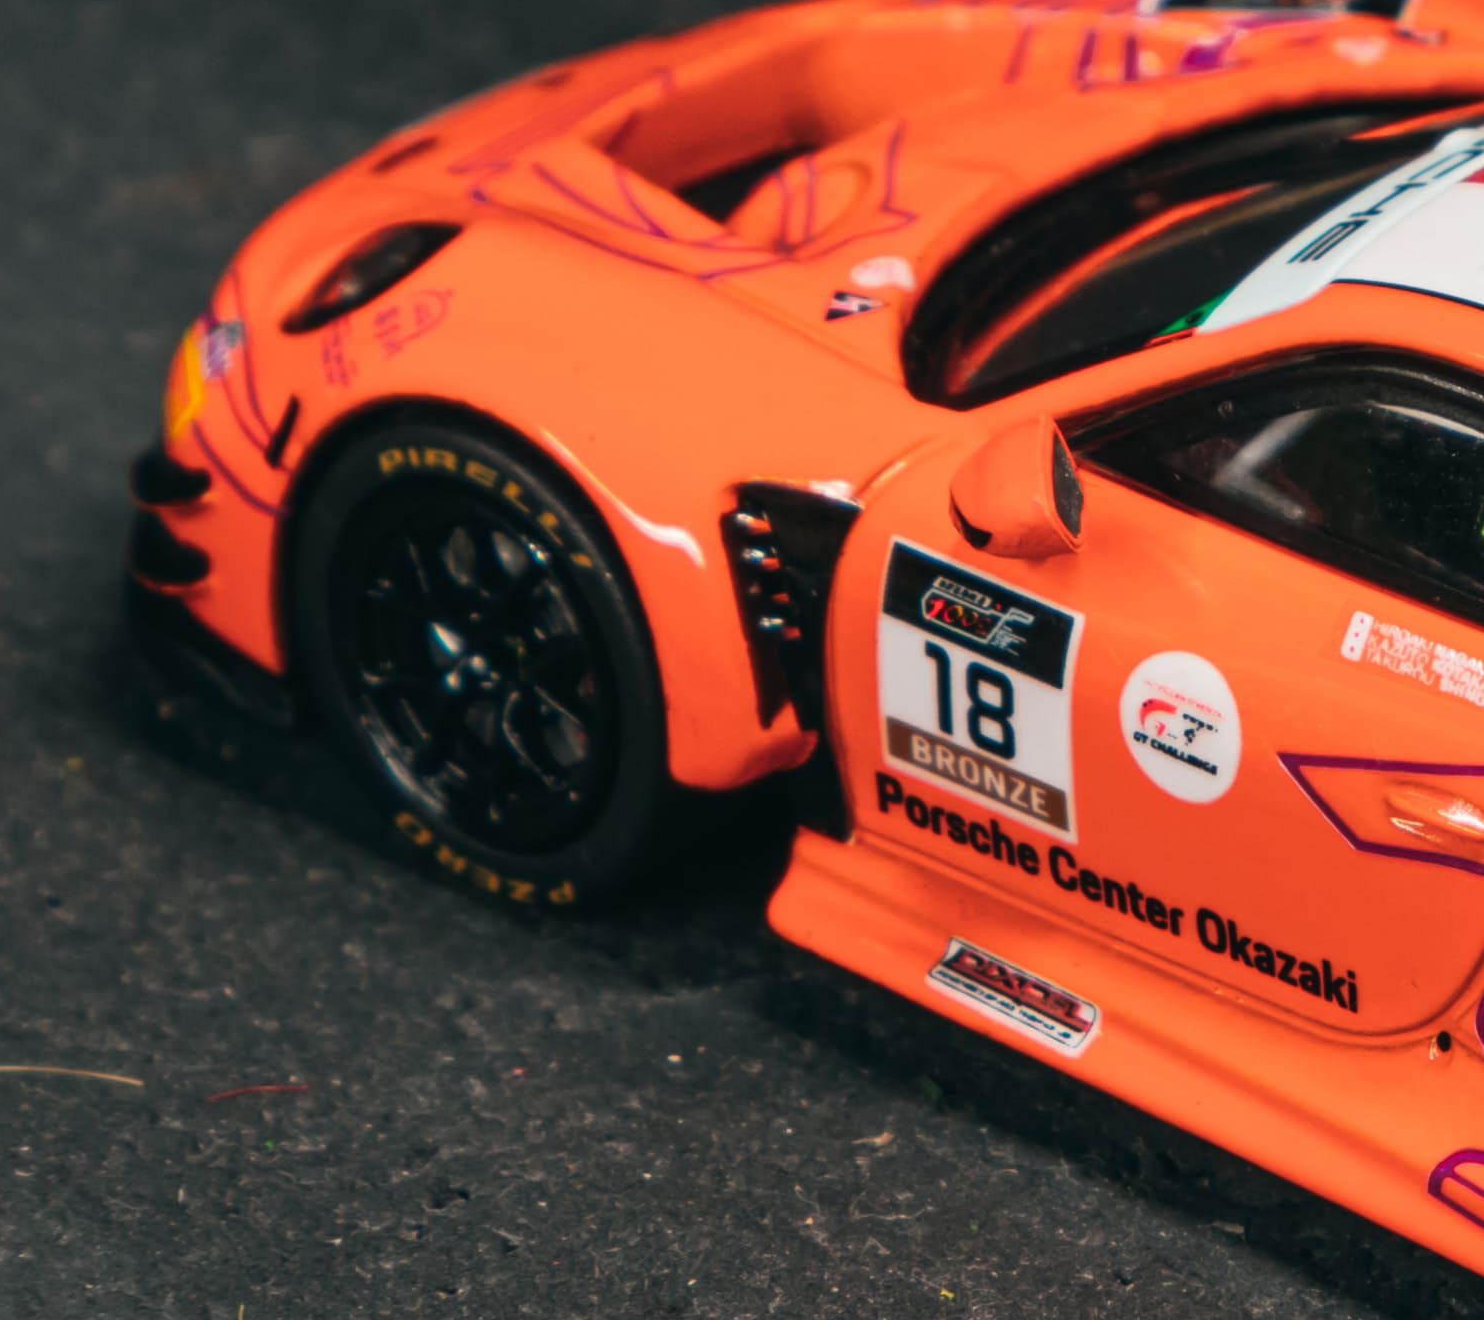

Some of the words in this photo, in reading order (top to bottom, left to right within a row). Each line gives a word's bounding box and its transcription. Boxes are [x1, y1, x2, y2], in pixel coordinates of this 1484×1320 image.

[378, 445, 594, 569] PIRELLI
[925, 638, 1016, 760] 18
[911, 733, 1053, 818] BRONZE
[875, 769, 1041, 876] Porsche
[1049, 845, 1185, 937] Center
[1195, 907, 1360, 1014] Okazaki
